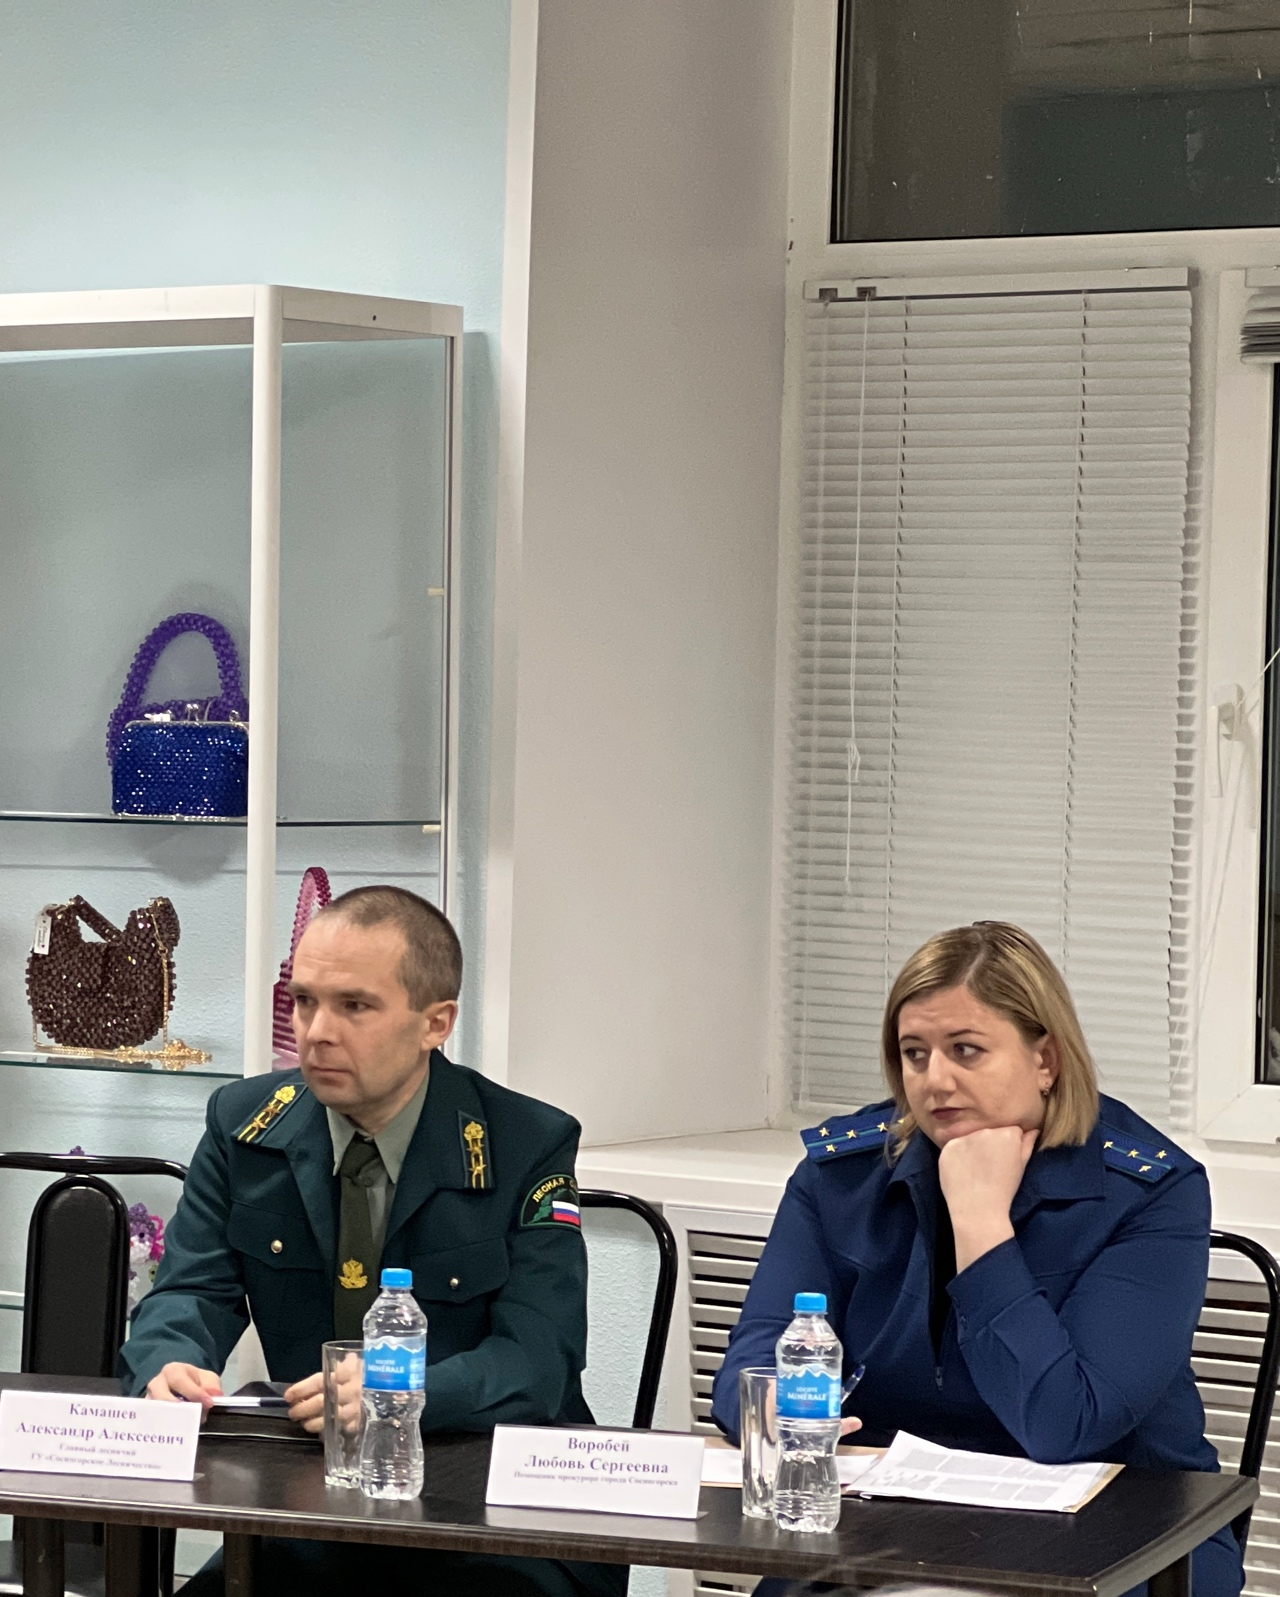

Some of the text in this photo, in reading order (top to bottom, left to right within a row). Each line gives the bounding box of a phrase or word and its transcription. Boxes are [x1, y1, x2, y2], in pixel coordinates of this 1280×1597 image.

[532, 1177, 565, 1203] ЛЕСНАЯ
[69, 1403, 137, 1420] Камашев
[16, 1422, 184, 1446] Александр Алексеевич
[568, 1436, 630, 1454] Воробей
[524, 1454, 669, 1474] Любовь Сергеевна
